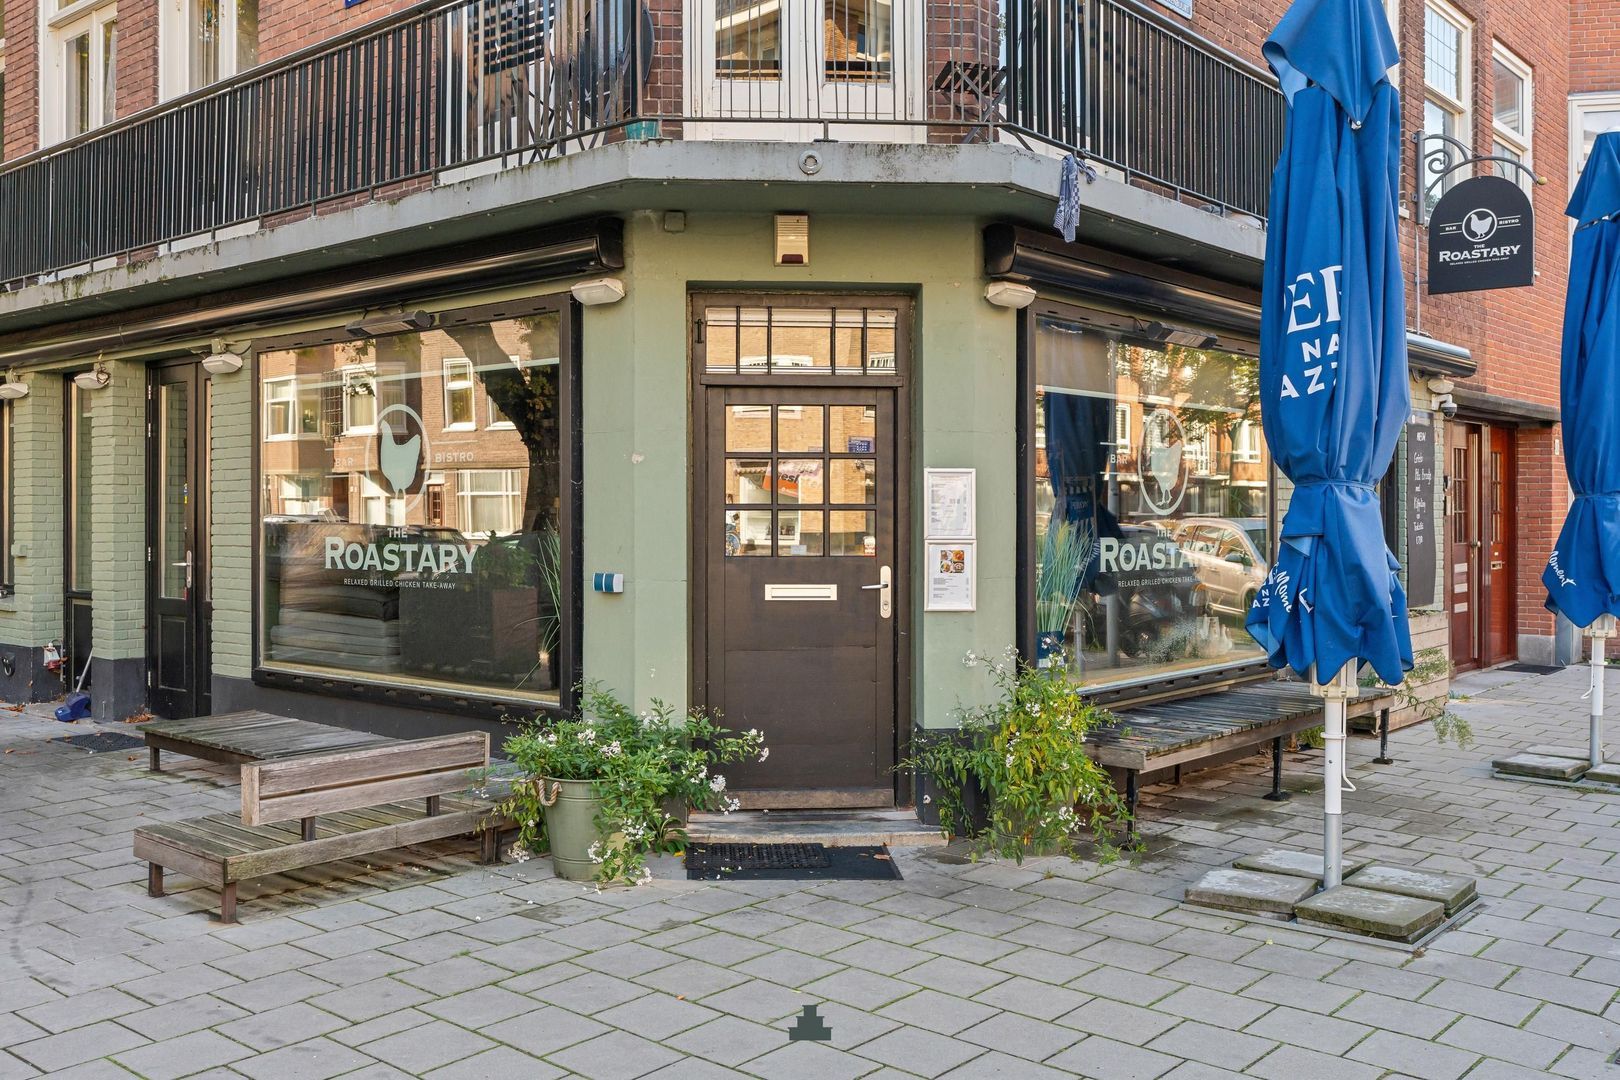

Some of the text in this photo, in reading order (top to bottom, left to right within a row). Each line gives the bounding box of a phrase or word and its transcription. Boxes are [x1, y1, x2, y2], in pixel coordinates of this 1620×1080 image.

[1439, 244, 1521, 263] ROASTARY
[334, 451, 474, 467] BAR BISTRO
[1110, 454, 1128, 464] BAR
[387, 527, 408, 538] THE
[1157, 528, 1172, 537] THE
[324, 536, 479, 574] ROASTARY
[343, 578, 456, 590] RELAXED GRILLED CHICKEN TAKE-AWAY
[1118, 580, 1140, 588] RELAXED
[1141, 578, 1160, 586] GRILLED
